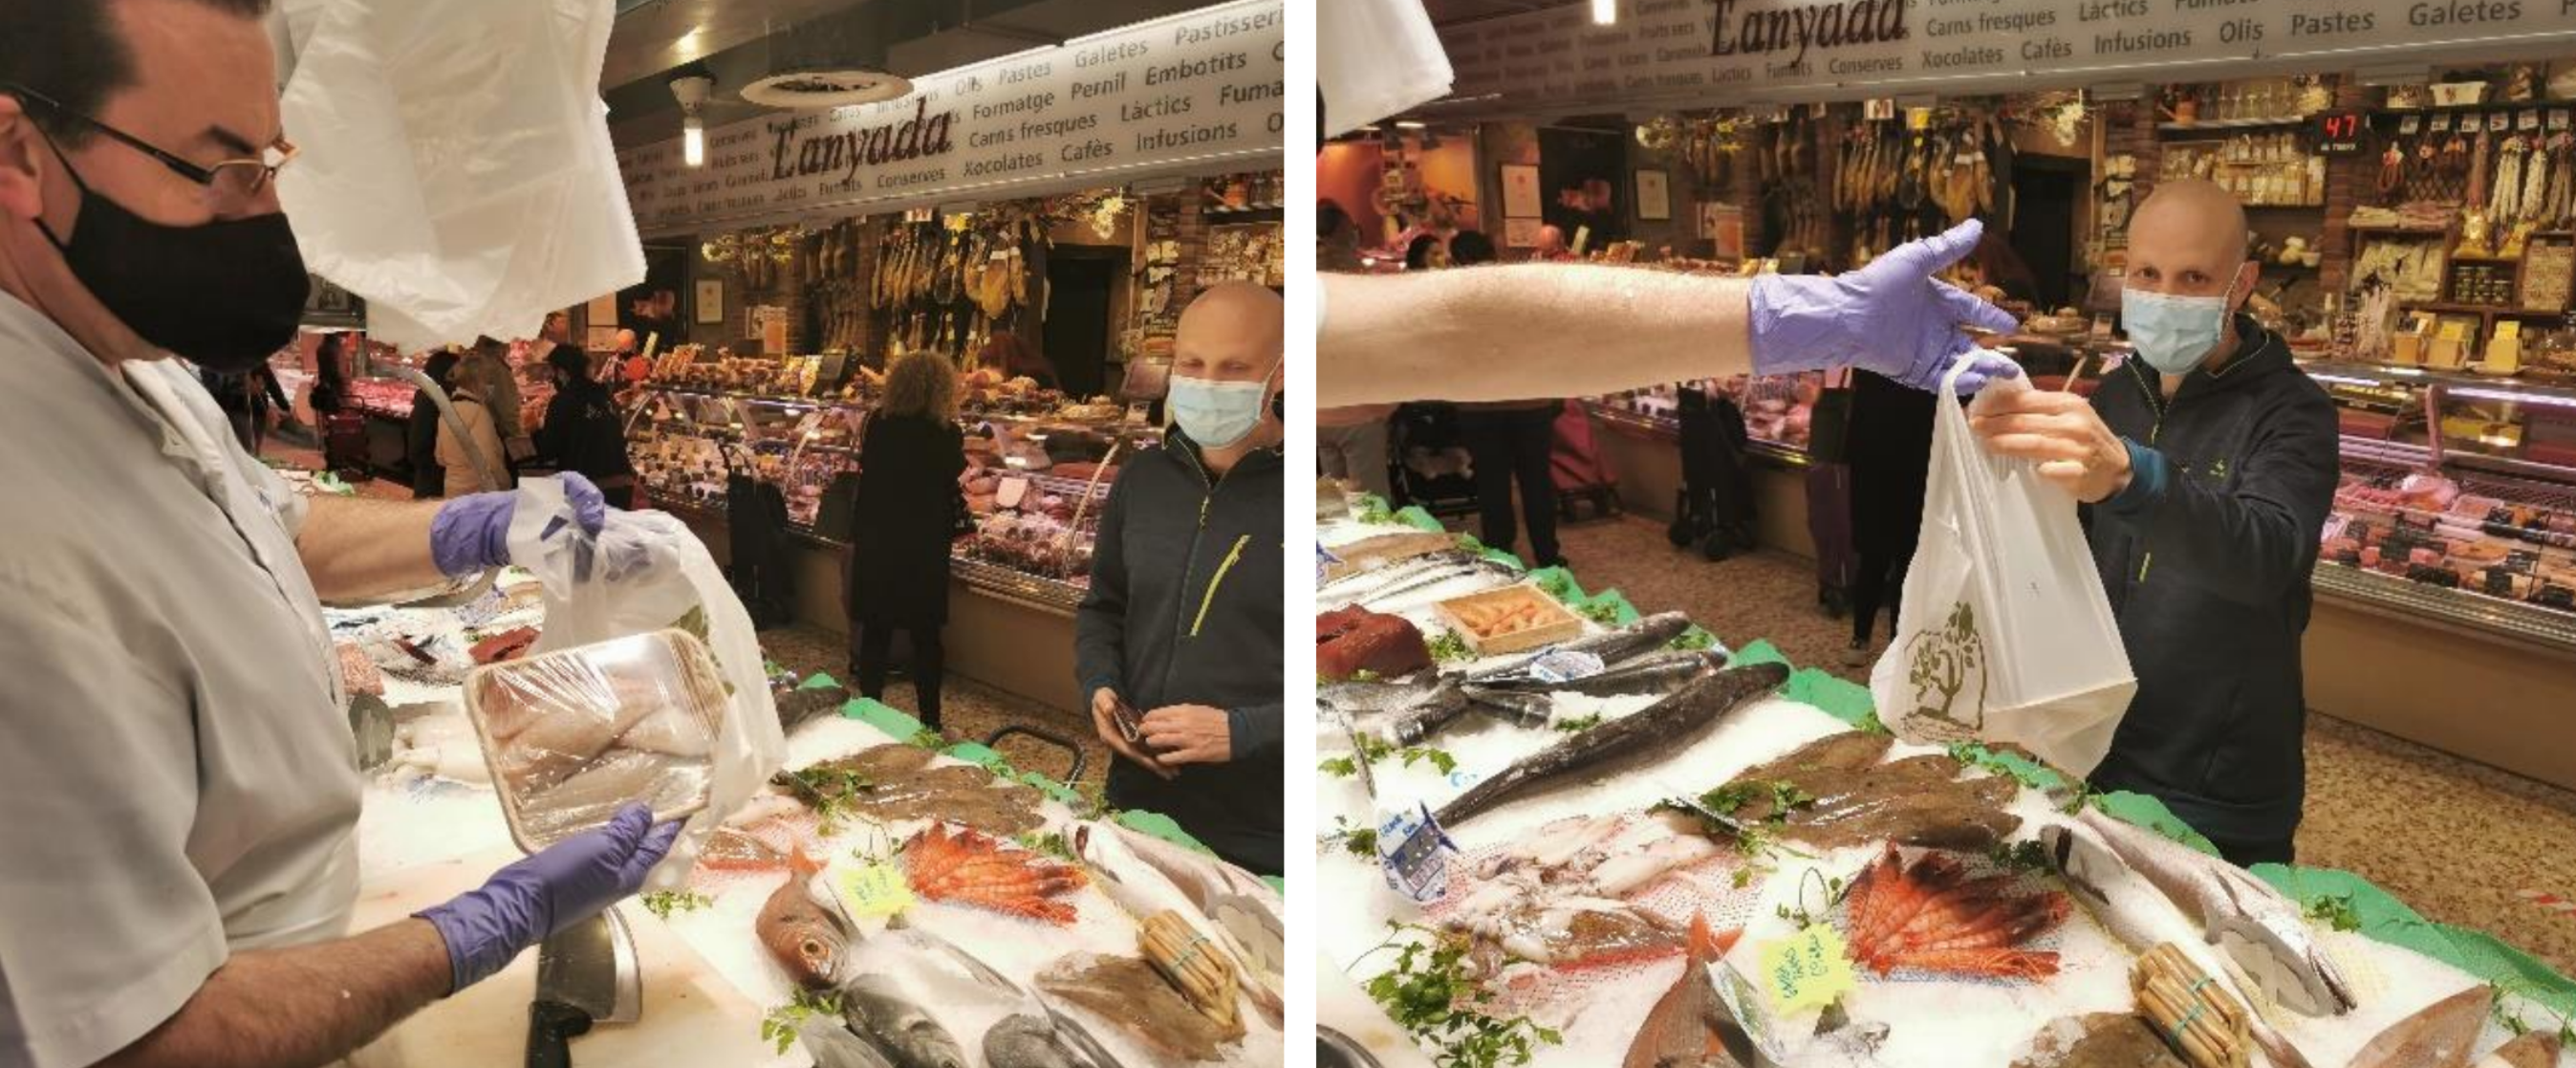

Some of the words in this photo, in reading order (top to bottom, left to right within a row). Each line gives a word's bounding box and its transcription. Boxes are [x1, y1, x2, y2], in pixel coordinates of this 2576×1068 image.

[1829, 55, 1903, 75] Conserves
[1922, 47, 2004, 70] Xocolates
[2021, 37, 2072, 60] Cafès
[2094, 30, 2192, 54] Infusions
[2219, 17, 2264, 44] Olis
[2291, 11, 2374, 36] Pastes
[2408, 0, 2522, 27] Galetes
[1926, 17, 1972, 37] Carns
[1980, 10, 2056, 34] fresques
[973, 92, 1054, 120] Formatge
[1072, 72, 1126, 99] Pernil
[1146, 52, 1246, 85] Embotits
[999, 61, 1051, 85] Pastes
[1075, 40, 1148, 68] Galetes
[969, 127, 1015, 148] Carns
[1020, 113, 1097, 140] fresques
[1121, 95, 1190, 121] Làctics
[2326, 114, 2357, 138] 47
[877, 168, 944, 188] Conserves
[963, 152, 1043, 177] Xocolates
[1061, 139, 1113, 162] Cafès
[1136, 122, 1237, 151] Infusions
